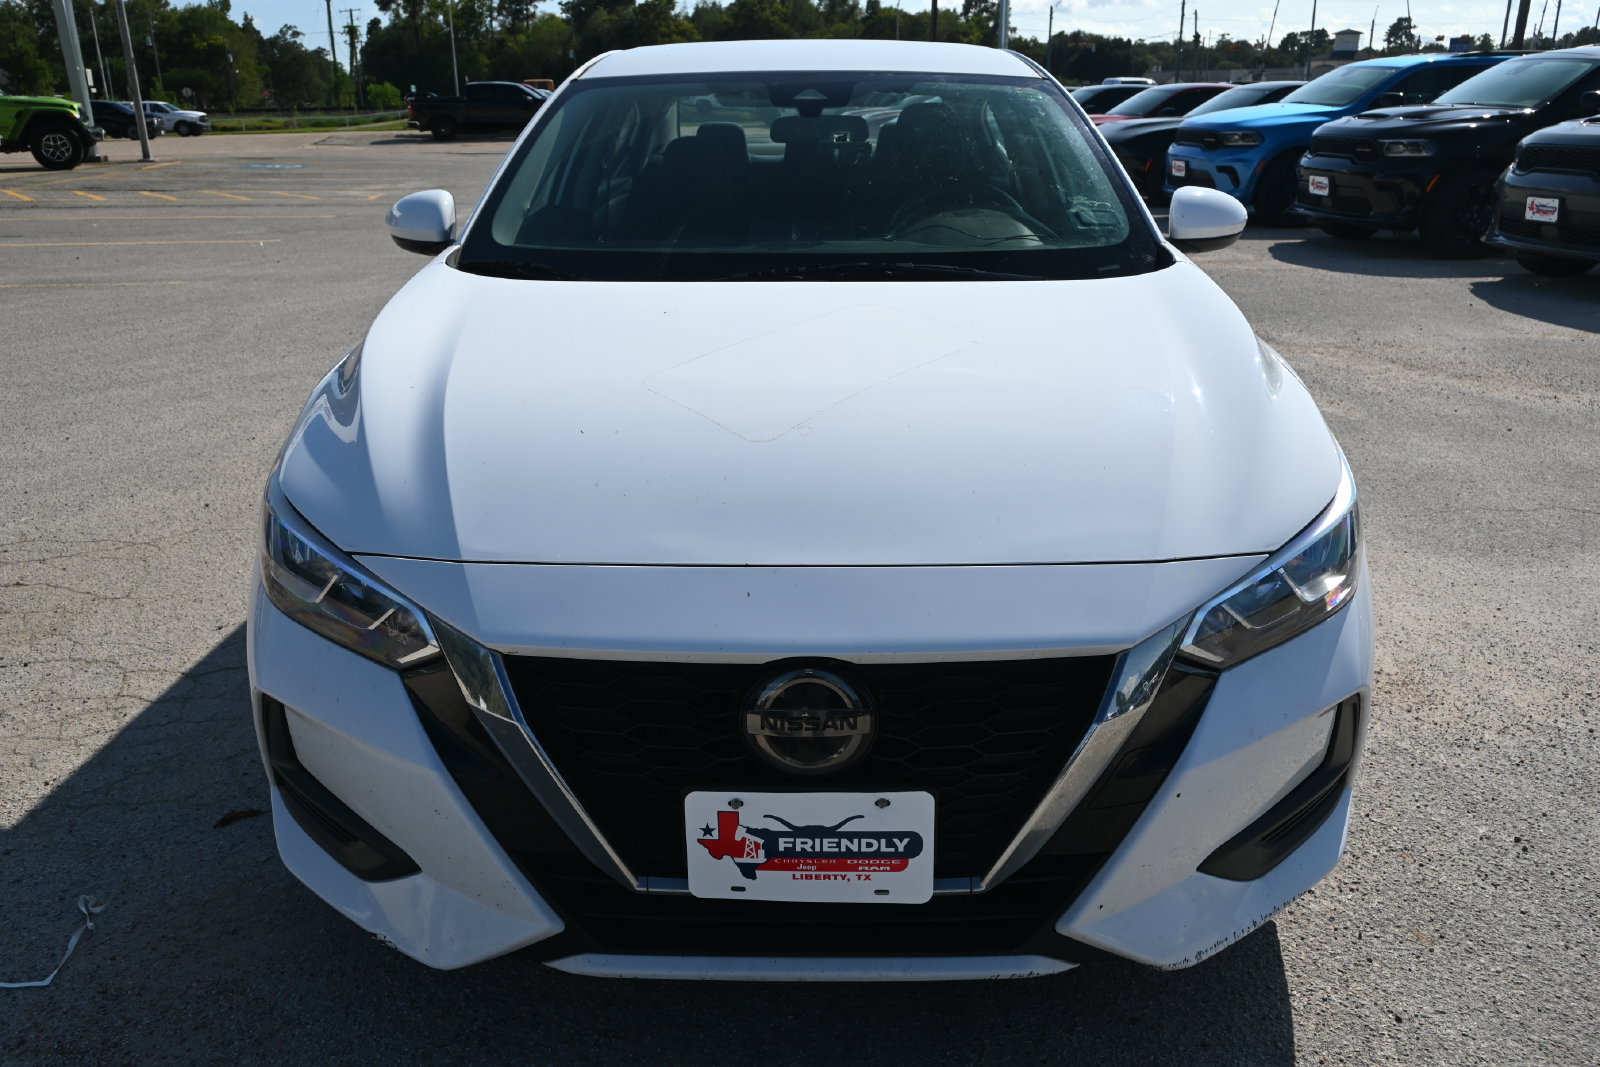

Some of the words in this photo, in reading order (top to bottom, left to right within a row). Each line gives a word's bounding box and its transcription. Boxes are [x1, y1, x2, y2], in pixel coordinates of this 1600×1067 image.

[760, 715, 858, 731] NISSAN
[778, 838, 911, 853] FRIENDLY
[792, 873, 851, 882] LIBERTY,
